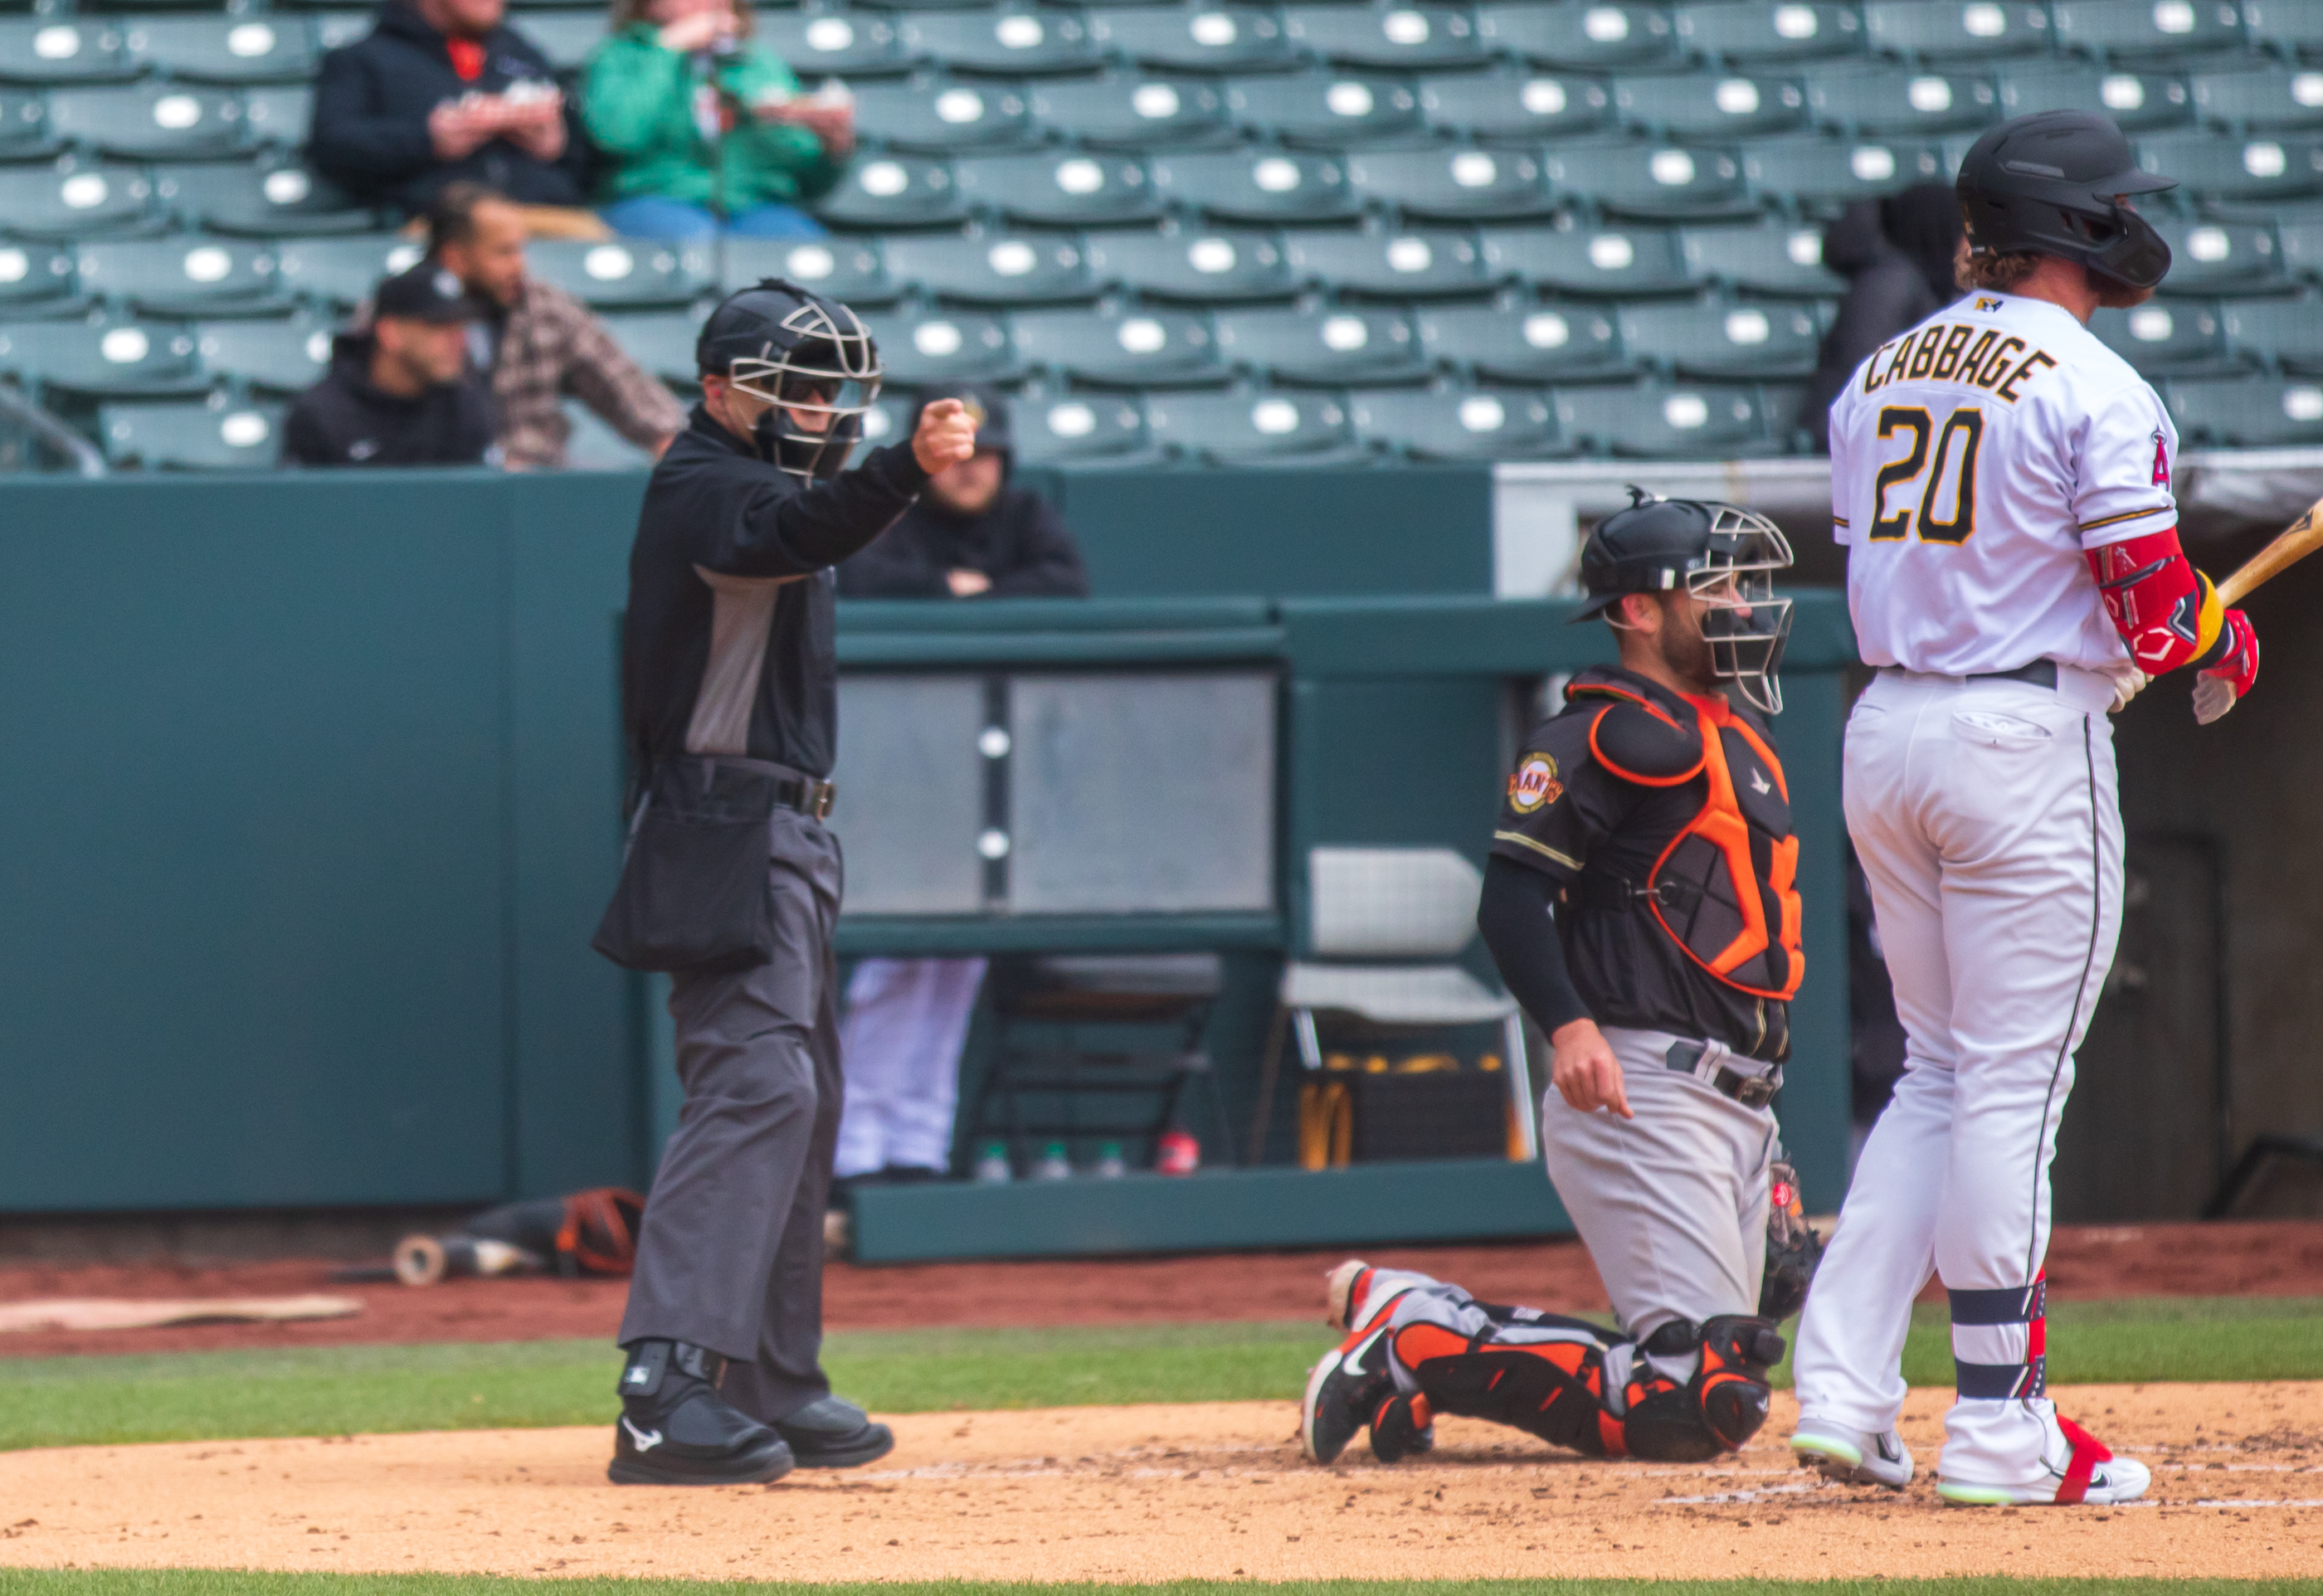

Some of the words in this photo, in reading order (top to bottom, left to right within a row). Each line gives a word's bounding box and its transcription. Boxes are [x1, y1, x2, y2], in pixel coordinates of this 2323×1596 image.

[1863, 324, 2058, 403] CABBAGE
[1868, 406, 1986, 547] 20
[2150, 424, 2170, 493] A
